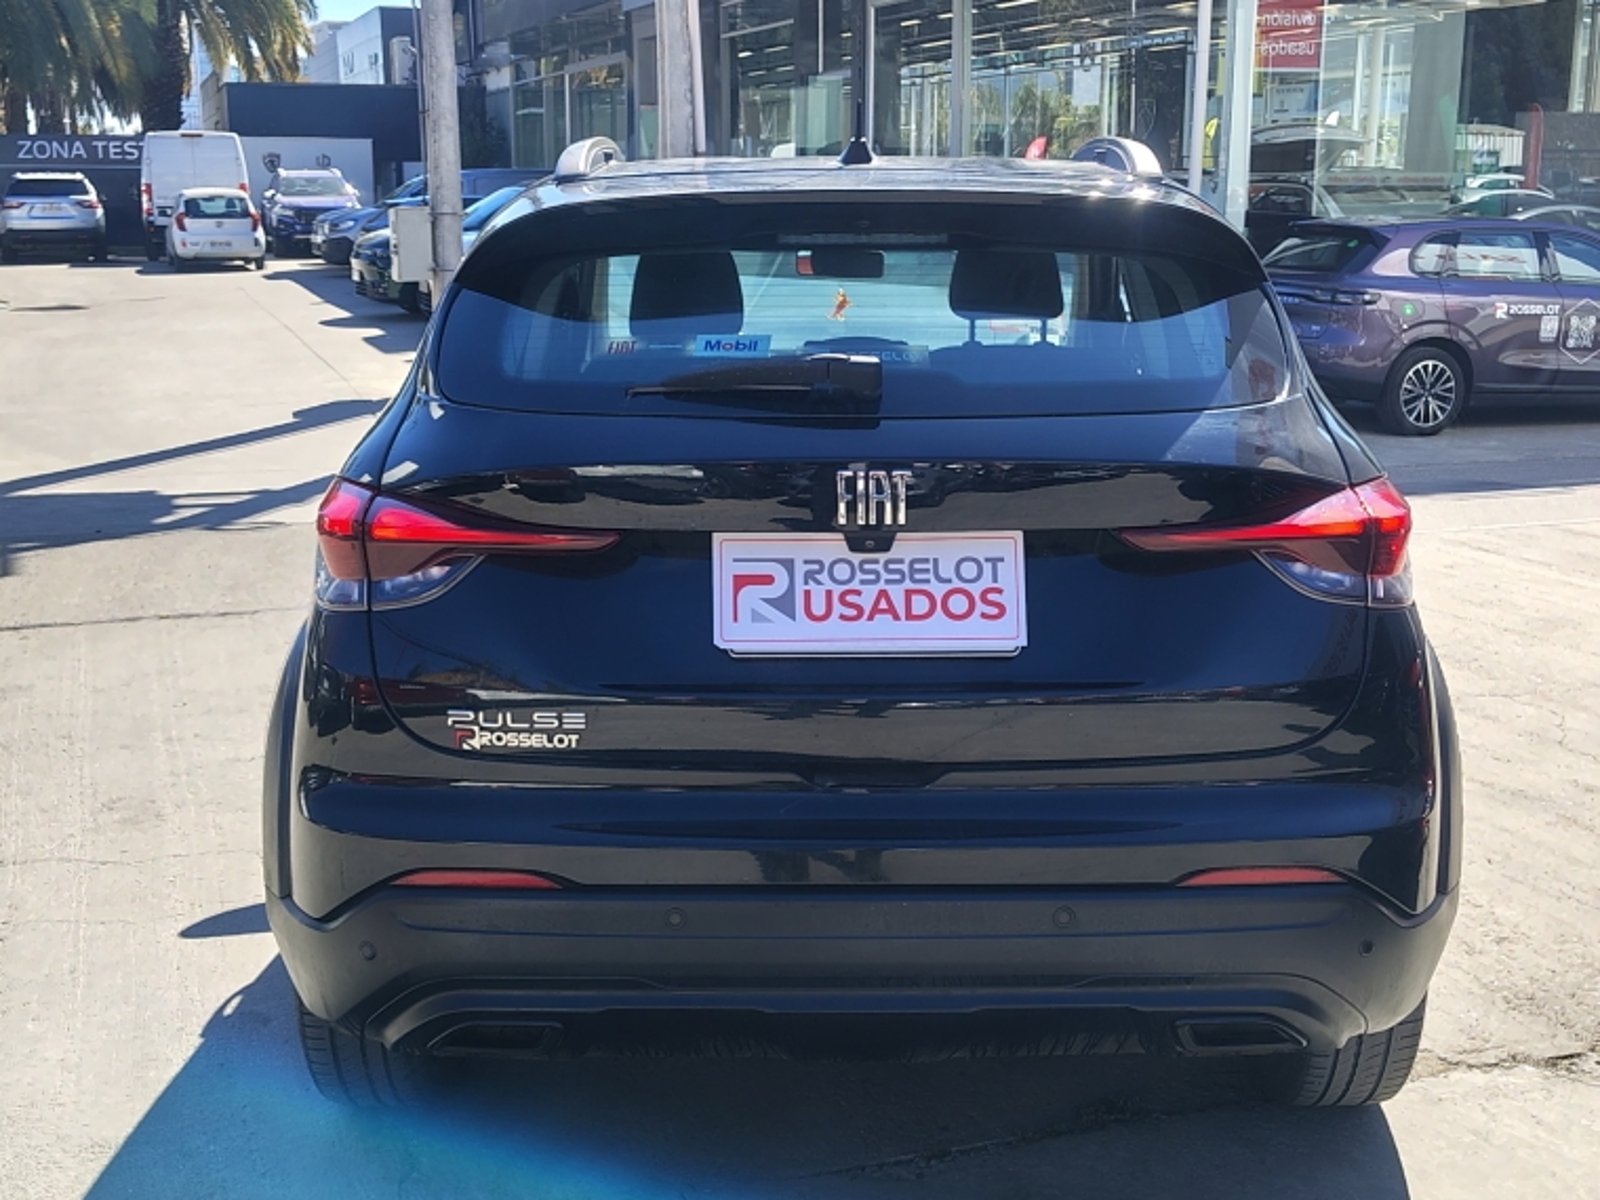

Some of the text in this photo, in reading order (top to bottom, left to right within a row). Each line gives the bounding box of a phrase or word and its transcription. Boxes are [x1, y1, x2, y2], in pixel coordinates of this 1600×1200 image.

[17, 140, 87, 159] ZONA
[607, 340, 638, 355] FIAT
[703, 340, 759, 352] Mobil
[836, 469, 912, 526] FIAT
[802, 556, 1005, 586] ROSSELOT
[803, 586, 1007, 623] USADOS
[447, 710, 586, 729] PULSE
[480, 731, 579, 748] ROSSELOT
